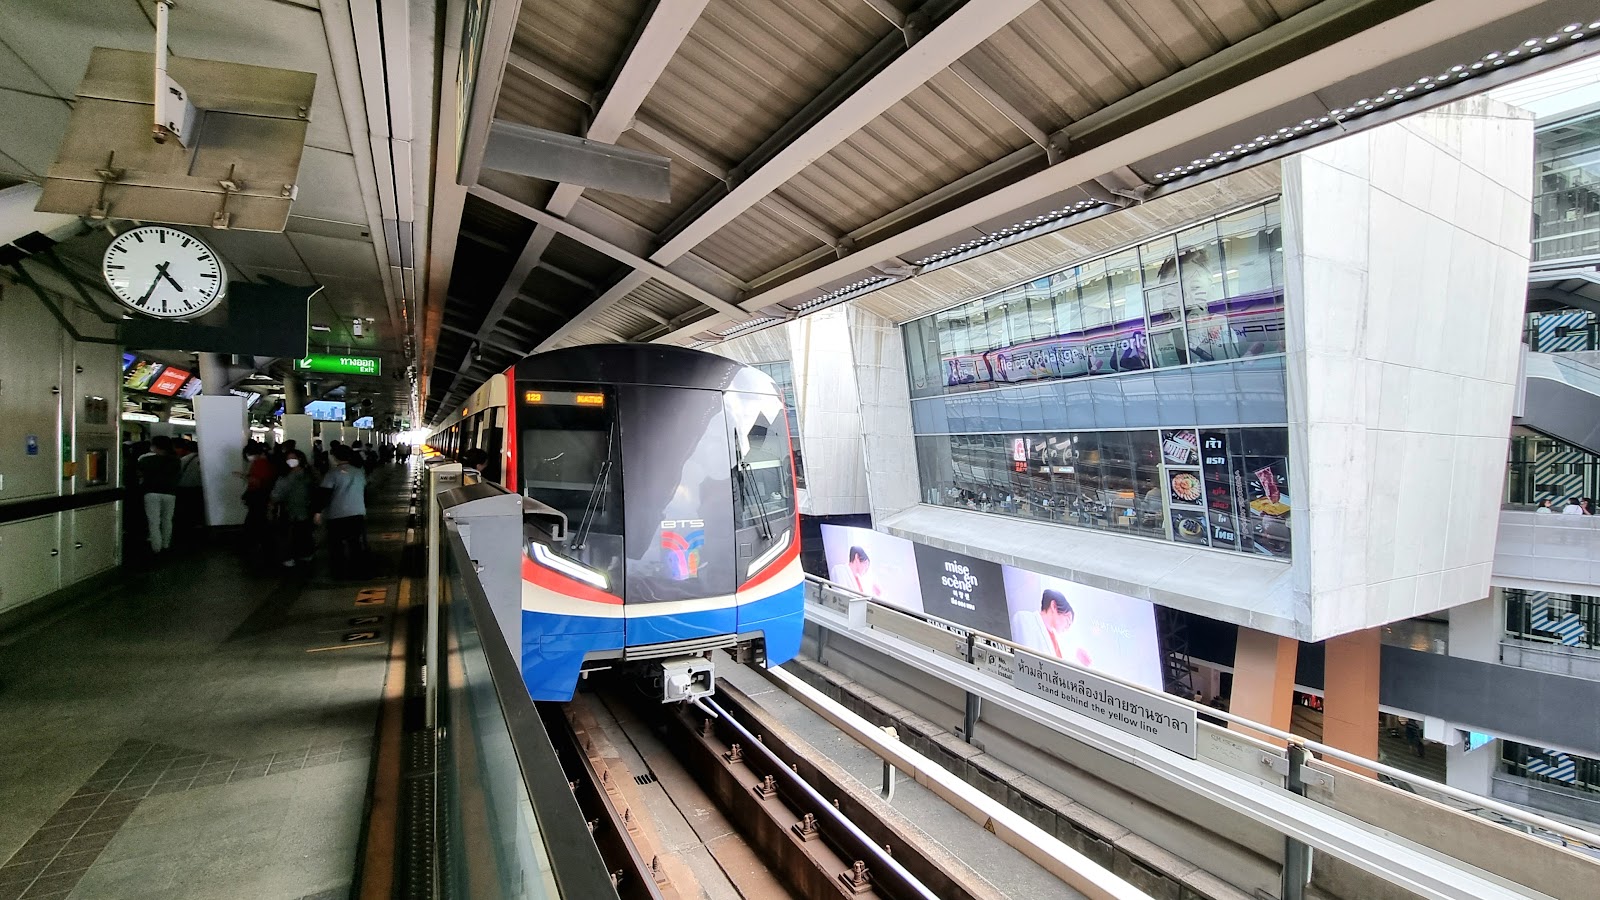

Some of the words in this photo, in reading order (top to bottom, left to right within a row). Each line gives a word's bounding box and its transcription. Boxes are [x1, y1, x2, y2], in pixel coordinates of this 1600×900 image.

[340, 357, 375, 367] ทางออก
[526, 393, 541, 402] 123
[661, 519, 705, 529] BTS
[945, 560, 970, 575] mise
[941, 574, 973, 593] scène
[964, 573, 978, 587] en
[1018, 658, 1188, 733] ห้ามล้ำเส้นเหลืองปลายชานชาลา
[1037, 682, 1059, 697] Stand
[1061, 691, 1089, 709] behind
[1091, 703, 1106, 715] the
[1108, 710, 1138, 727] yellow
[1140, 720, 1158, 735] line
